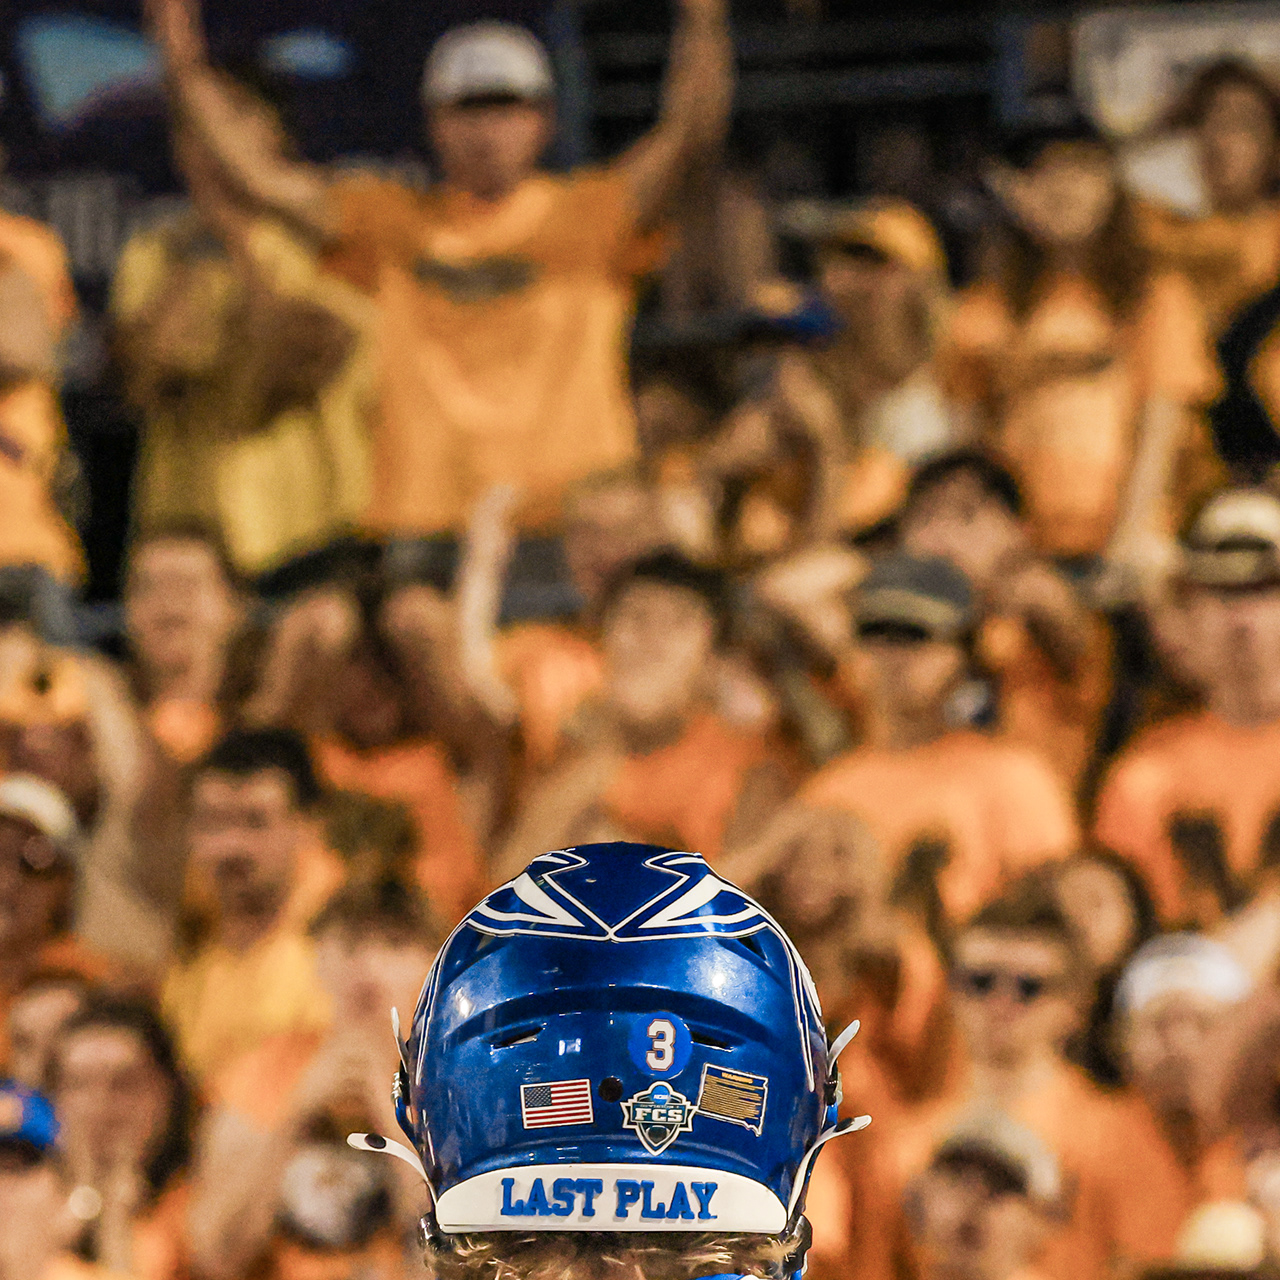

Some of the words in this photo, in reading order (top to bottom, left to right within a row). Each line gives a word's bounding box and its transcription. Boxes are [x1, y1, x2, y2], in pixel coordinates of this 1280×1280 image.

[646, 1019, 676, 1071] 3
[634, 1107, 683, 1122] FCS
[500, 1177, 603, 1217] LAST
[616, 1178, 718, 1220] PLAY
